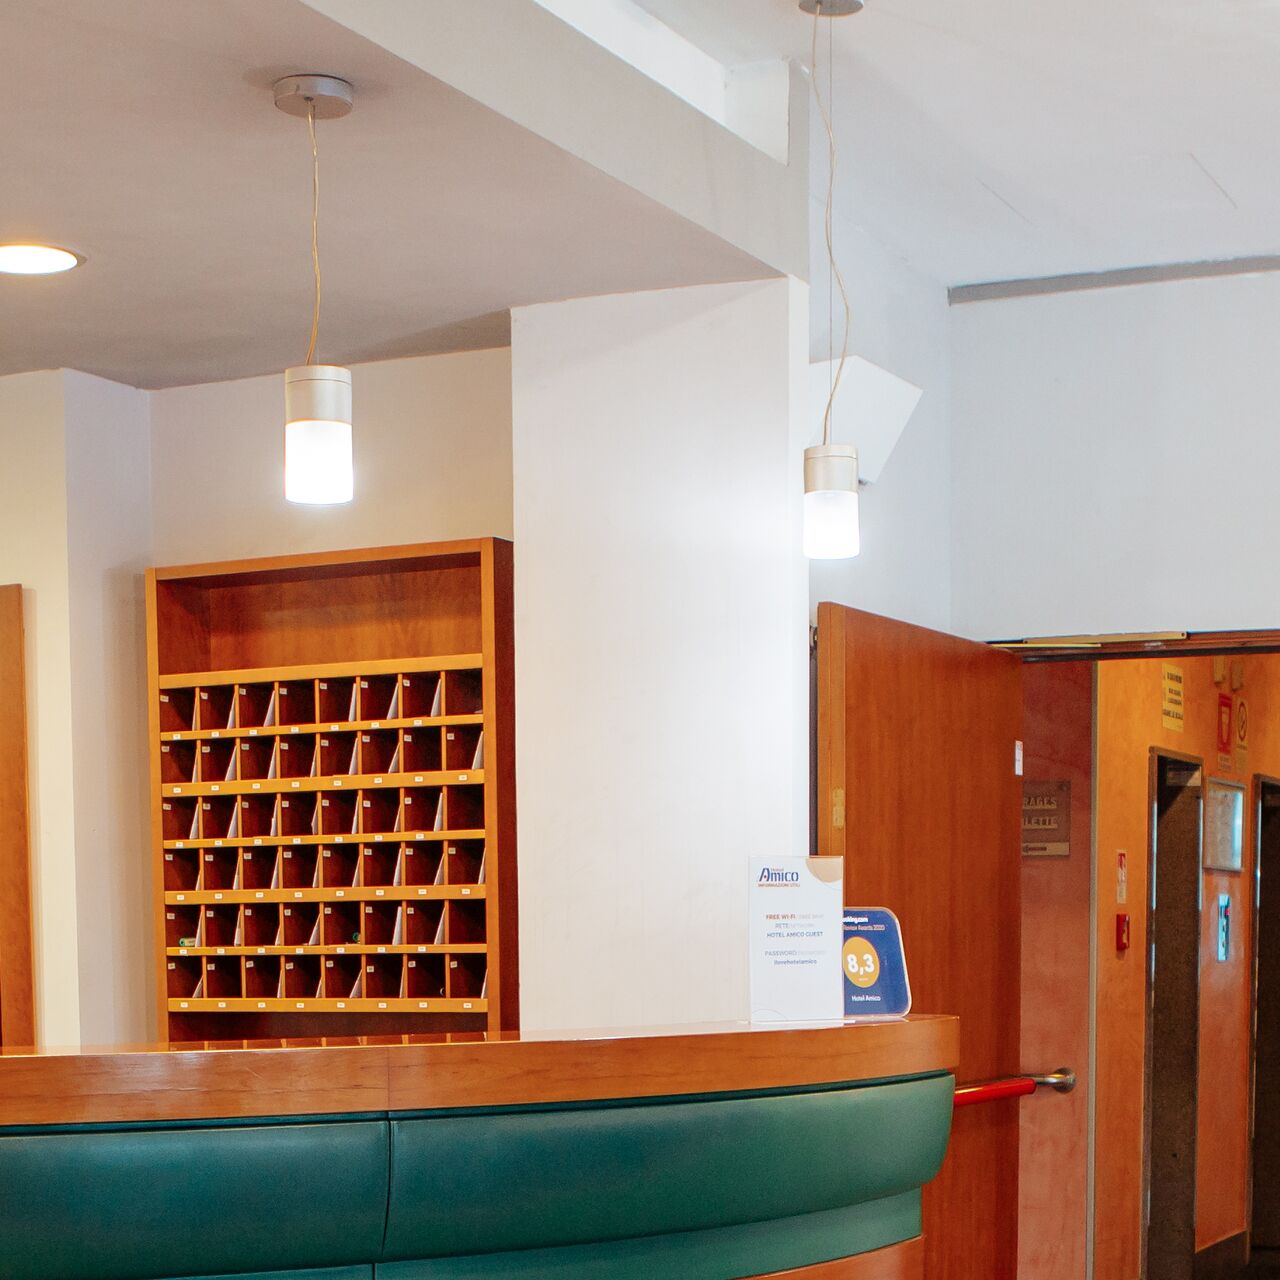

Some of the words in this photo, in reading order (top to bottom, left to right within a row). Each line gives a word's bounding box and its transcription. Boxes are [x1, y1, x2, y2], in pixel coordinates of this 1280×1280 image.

[758, 867, 800, 882] Amico
[846, 953, 875, 976] 8,3
[865, 994, 881, 1002] Amico
